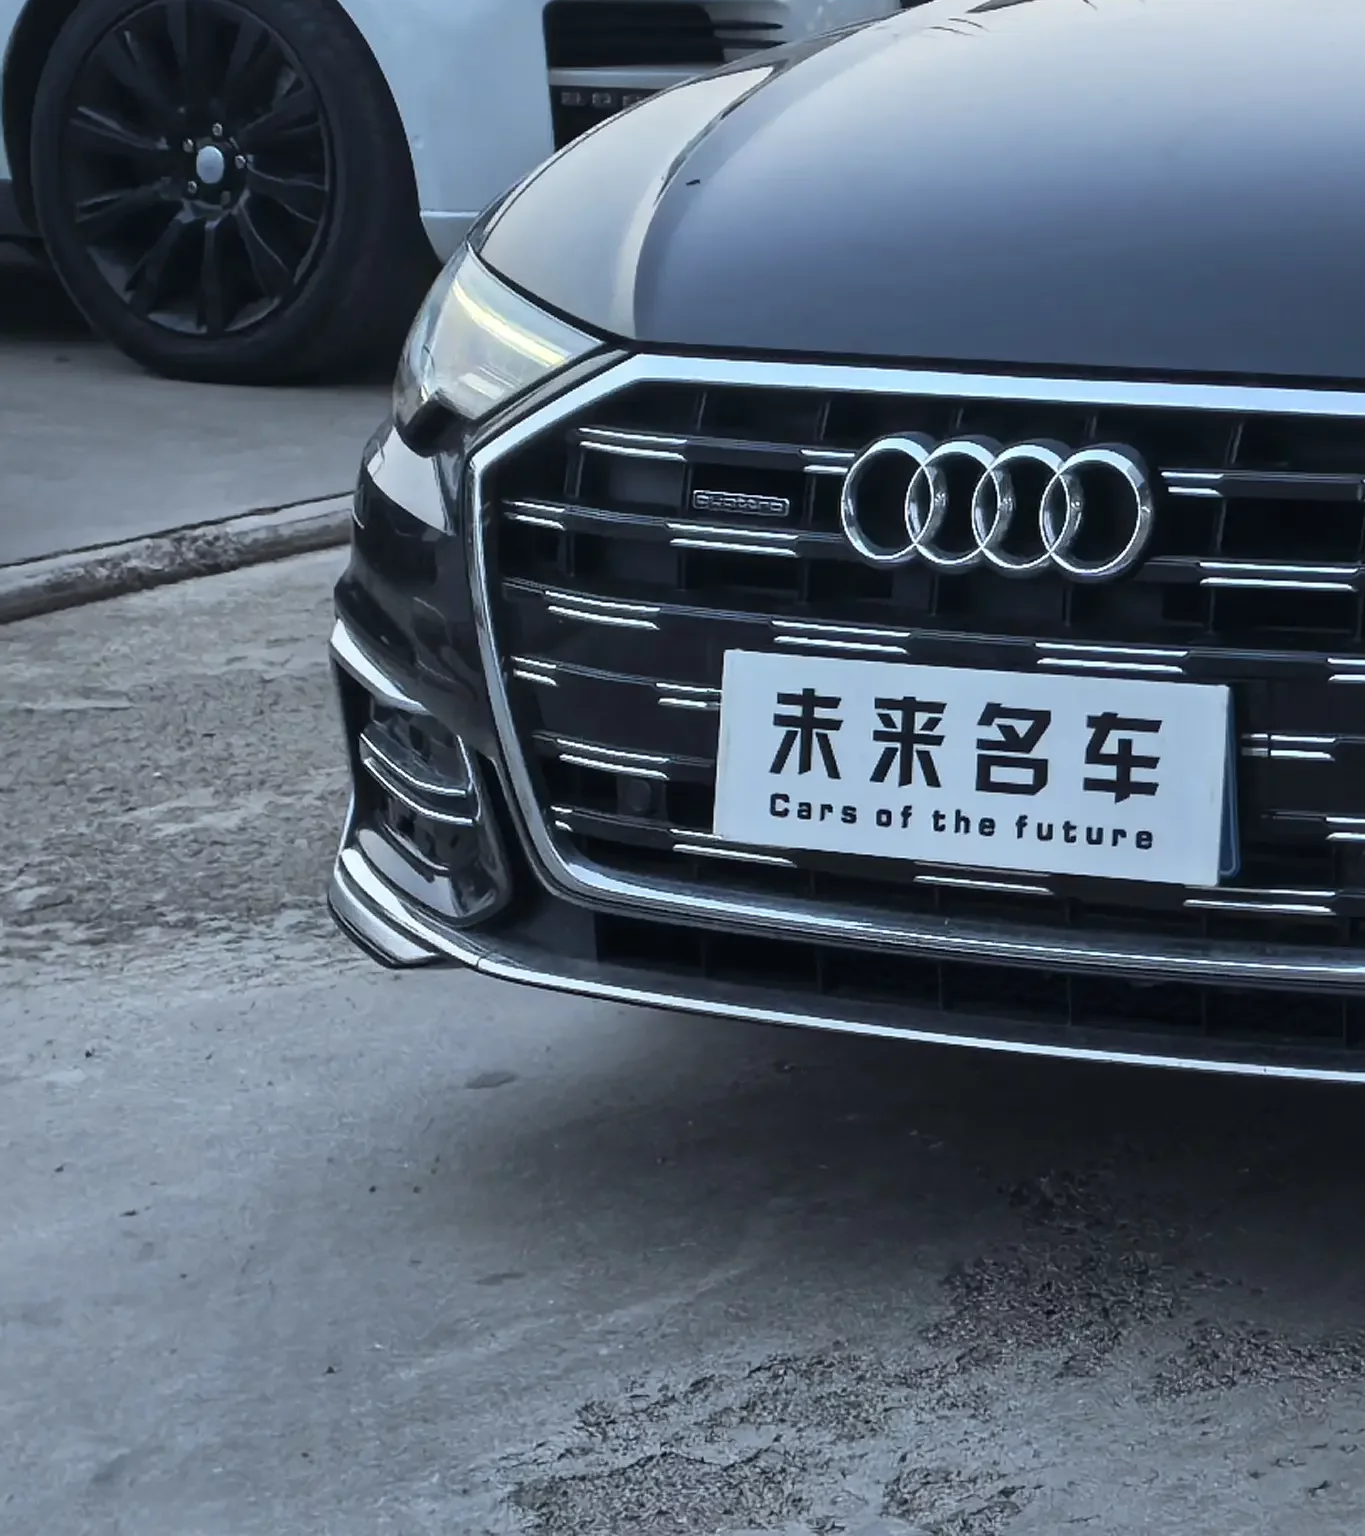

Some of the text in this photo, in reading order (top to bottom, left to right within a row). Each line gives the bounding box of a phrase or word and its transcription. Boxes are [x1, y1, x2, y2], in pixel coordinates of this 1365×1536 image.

[769, 687, 1163, 804] 未来名车
[769, 793, 1154, 850] Cars of the future
